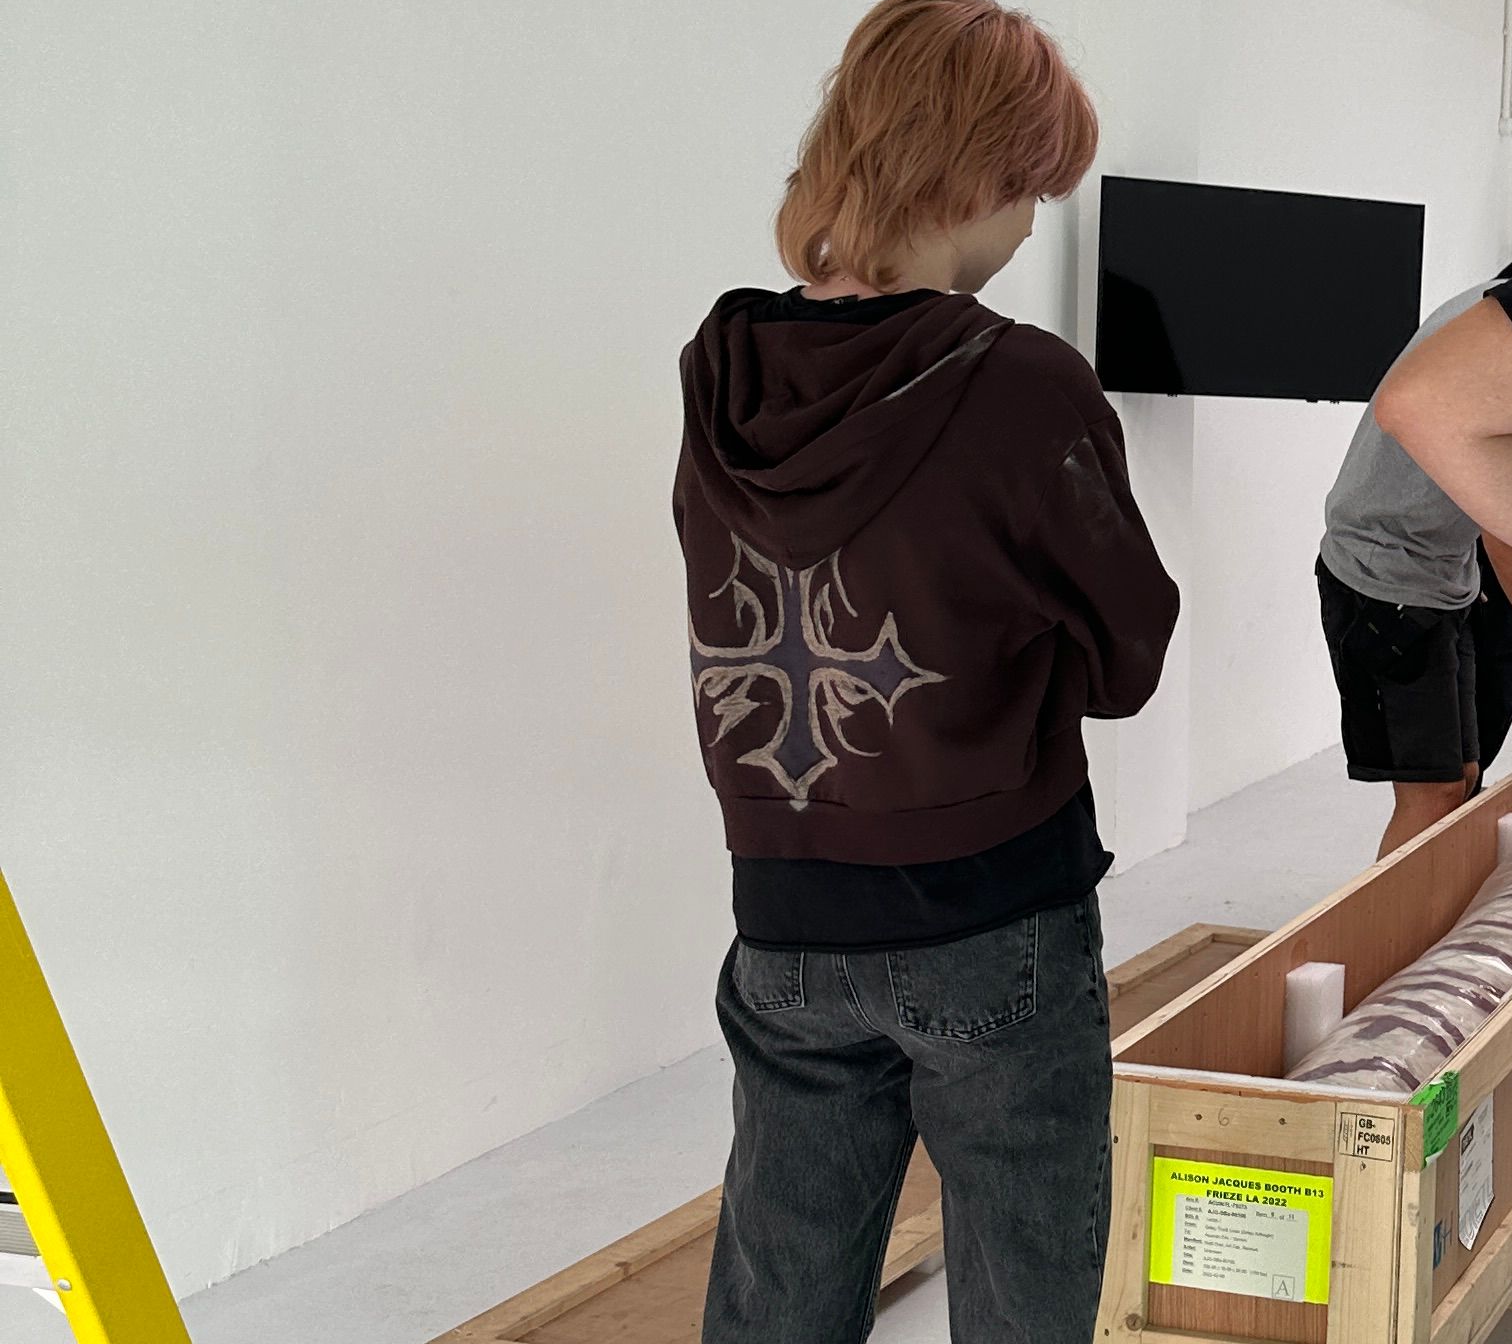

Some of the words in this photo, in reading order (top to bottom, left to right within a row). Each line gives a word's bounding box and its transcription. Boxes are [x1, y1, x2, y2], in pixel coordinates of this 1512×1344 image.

[1358, 1118, 1376, 1129] GB-
[1356, 1144, 1370, 1155] HT
[1170, 1171, 1209, 1184] ALISON
[1212, 1176, 1261, 1191] JACQUES
[1264, 1183, 1301, 1196] BOOTH
[1304, 1187, 1324, 1199] B13
[1206, 1189, 1243, 1202] FRIEZE
[1245, 1193, 1260, 1204] LA
[1261, 1196, 1288, 1208] 2022
[1274, 1279, 1290, 1297] A
